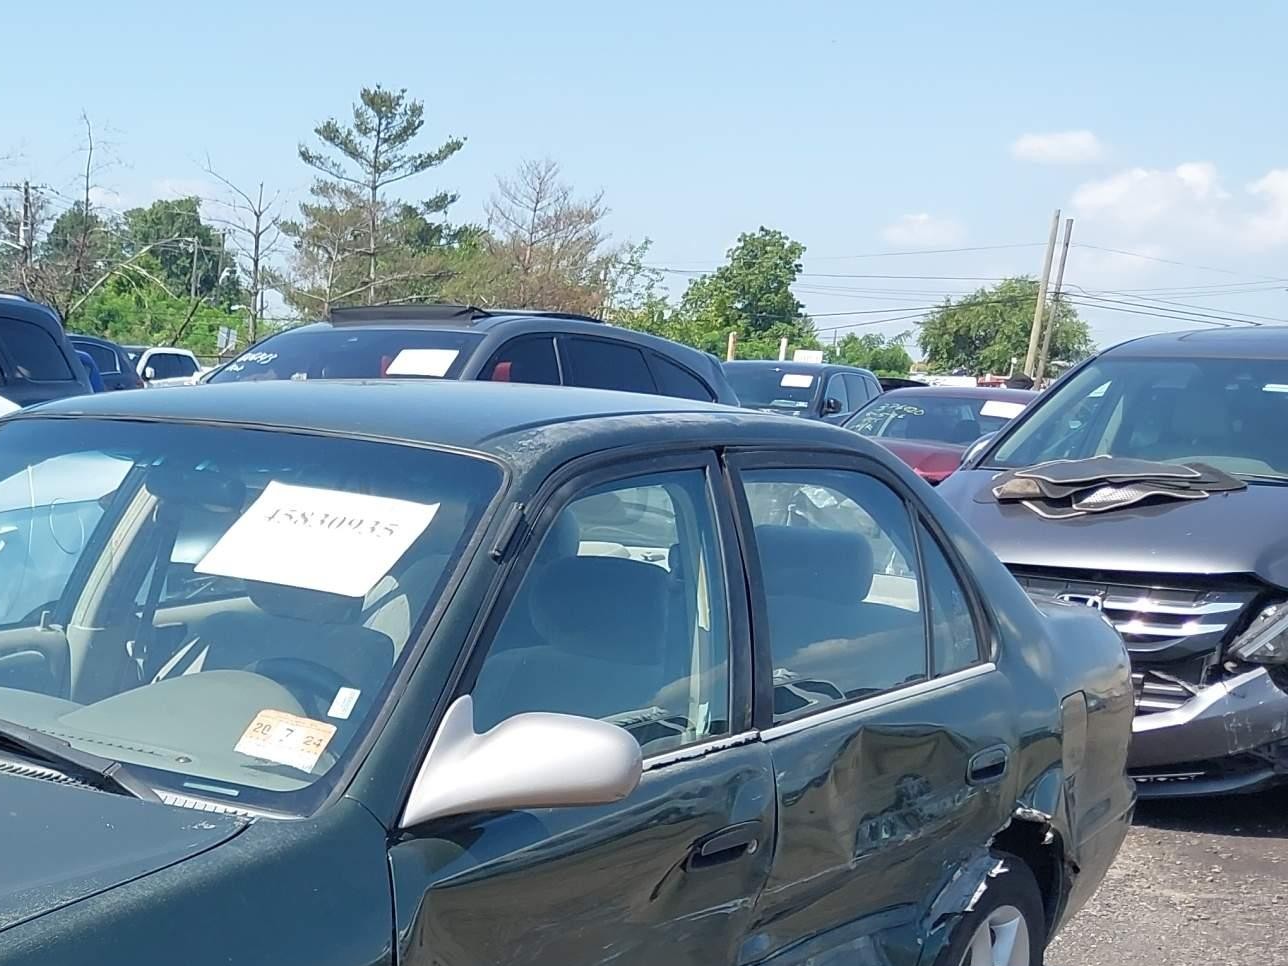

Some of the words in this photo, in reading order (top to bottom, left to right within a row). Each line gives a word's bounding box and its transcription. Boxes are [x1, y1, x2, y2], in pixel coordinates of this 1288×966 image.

[265, 507, 401, 538] 45830935
[252, 721, 273, 736] 20
[284, 727, 296, 738] 7
